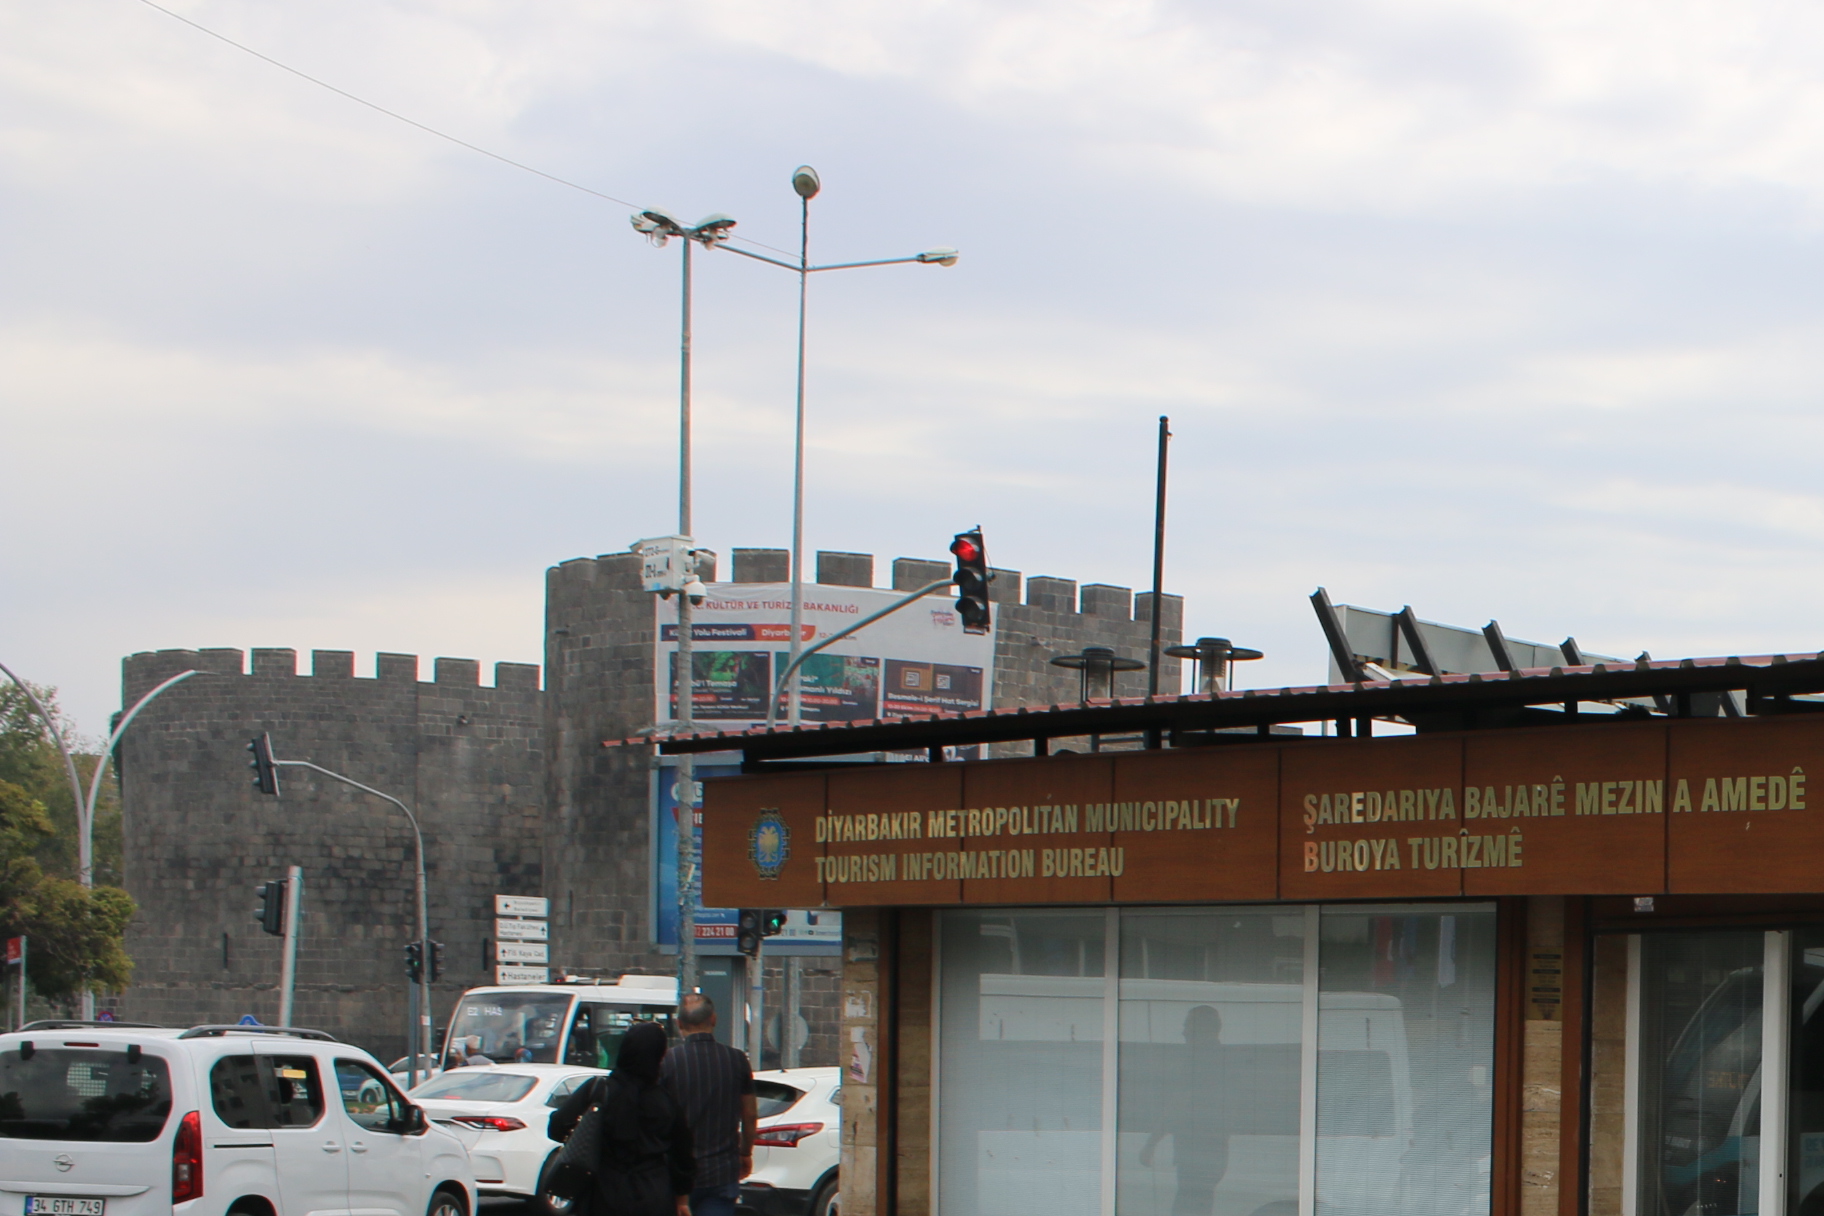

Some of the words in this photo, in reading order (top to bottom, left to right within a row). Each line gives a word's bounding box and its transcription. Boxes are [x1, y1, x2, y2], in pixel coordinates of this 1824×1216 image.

[705, 600, 744, 610] KÜLTÜR
[747, 601, 760, 610] VE
[762, 600, 792, 610] TURİZ
[803, 601, 859, 614] BAKANLIĞI
[711, 628, 747, 636] Festivali
[1303, 788, 1456, 834] ŞAREDARIYA
[1464, 775, 1566, 819] BAJARÊ
[1575, 780, 1664, 816] MEZIN
[1672, 779, 1693, 813] A
[1701, 766, 1806, 812] AMEDÊ
[815, 809, 922, 843] DİYARBAKIR
[928, 804, 1078, 838] METROPOLITAN
[1085, 798, 1240, 833] MUNICIPALITY
[1303, 838, 1400, 872] BUROYA
[1407, 826, 1523, 871] TURÎZMÊ
[815, 853, 896, 883] TOURISM
[902, 849, 1035, 880] INFORMATION
[1042, 847, 1125, 877] BUREAU
[702, 927, 715, 936] 224
[508, 972, 546, 980] Hastaneler
[33, 1199, 46, 1212] 34
[53, 1200, 74, 1213] GTH
[80, 1201, 101, 1214] 749
